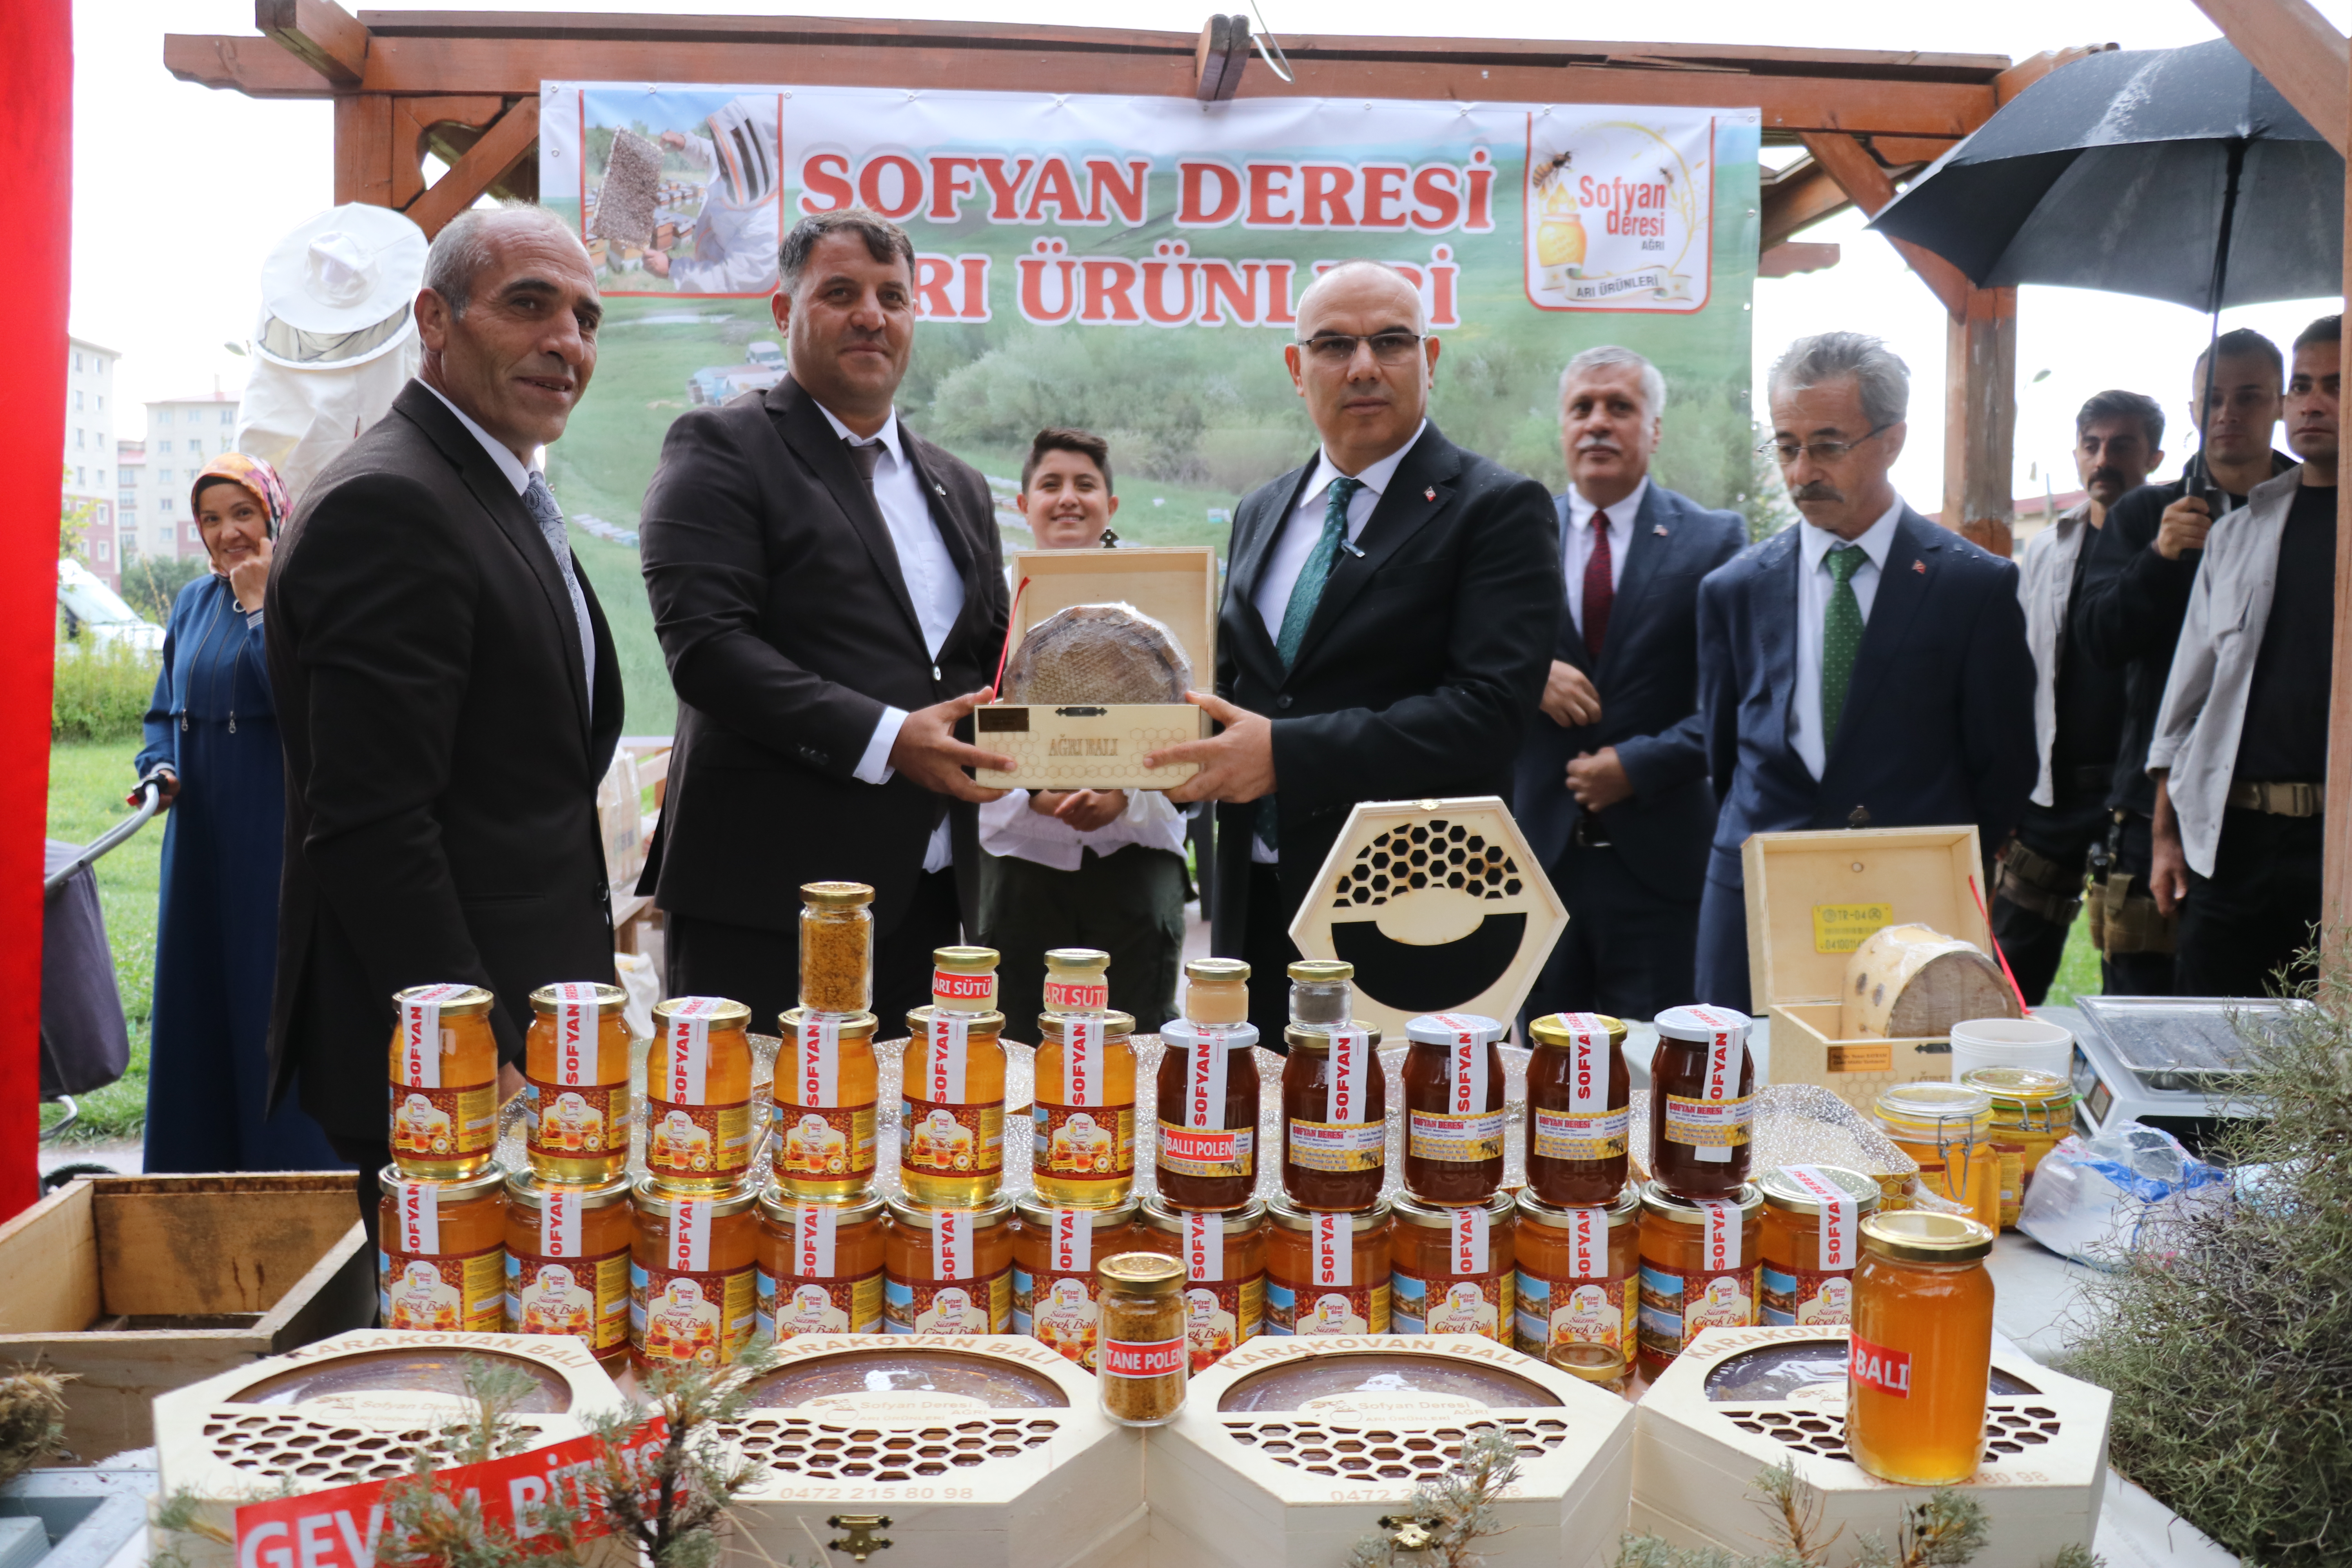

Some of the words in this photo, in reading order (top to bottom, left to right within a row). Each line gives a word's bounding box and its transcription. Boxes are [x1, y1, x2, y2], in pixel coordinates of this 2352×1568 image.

[802, 154, 1148, 222] SOFYAN
[1179, 151, 1492, 229] DERESİ
[1580, 175, 1666, 216] Sofyan
[1607, 209, 1665, 236] deresi
[1641, 239, 1664, 251] AĞRI
[916, 259, 987, 317] RI
[1577, 285, 1595, 298] ARI
[1599, 274, 1659, 296] ÜRÜNLERİ
[1048, 734, 1083, 756] AĞRI
[1086, 738, 1118, 756] BALI
[933, 981, 950, 994] ARI
[954, 979, 992, 996] SÜTÜ
[1046, 985, 1066, 1004] ARI
[410, 1006, 423, 1088] SOFYAN
[566, 1004, 580, 1085] SOFYAN
[675, 1023, 690, 1104] SOFYAN
[806, 1023, 820, 1107] SOFYAN
[935, 1021, 950, 1104] SOFYAN
[1073, 1023, 1086, 1106] SOFYAN
[1336, 1038, 1351, 1120] SOFYAN
[1457, 1031, 1472, 1112] SOFYAN
[1710, 1033, 1728, 1099] OFYAN
[1194, 1044, 1210, 1126] SOFYAN
[1166, 1136, 1194, 1155] BALLI
[1196, 1141, 1234, 1156] POLEN
[549, 1192, 563, 1256] OFYAN
[1460, 1207, 1473, 1273] OFYAN
[525, 1344, 597, 1370] BALI
[776, 1335, 976, 1358] ARAKOVAN
[984, 1341, 1065, 1365] BALI
[1105, 1348, 1141, 1370] TANE
[1145, 1347, 1185, 1370] POLEN
[1216, 1338, 1435, 1370] KARAKOVAN
[1447, 1343, 1534, 1367] BALI
[1684, 1327, 1851, 1360] KARAKOVA
[1855, 1348, 1909, 1390] BALI
[860, 1401, 916, 1410] Sofyan
[1358, 1402, 1414, 1410] Sofyan
[780, 1488, 842, 1499] 0472
[850, 1488, 897, 1499] 215
[905, 1488, 935, 1499] 80
[944, 1488, 974, 1499] 98
[1981, 1472, 2011, 1483] 80
[2016, 1471, 2049, 1482] 98
[1331, 1489, 1391, 1503] 0472
